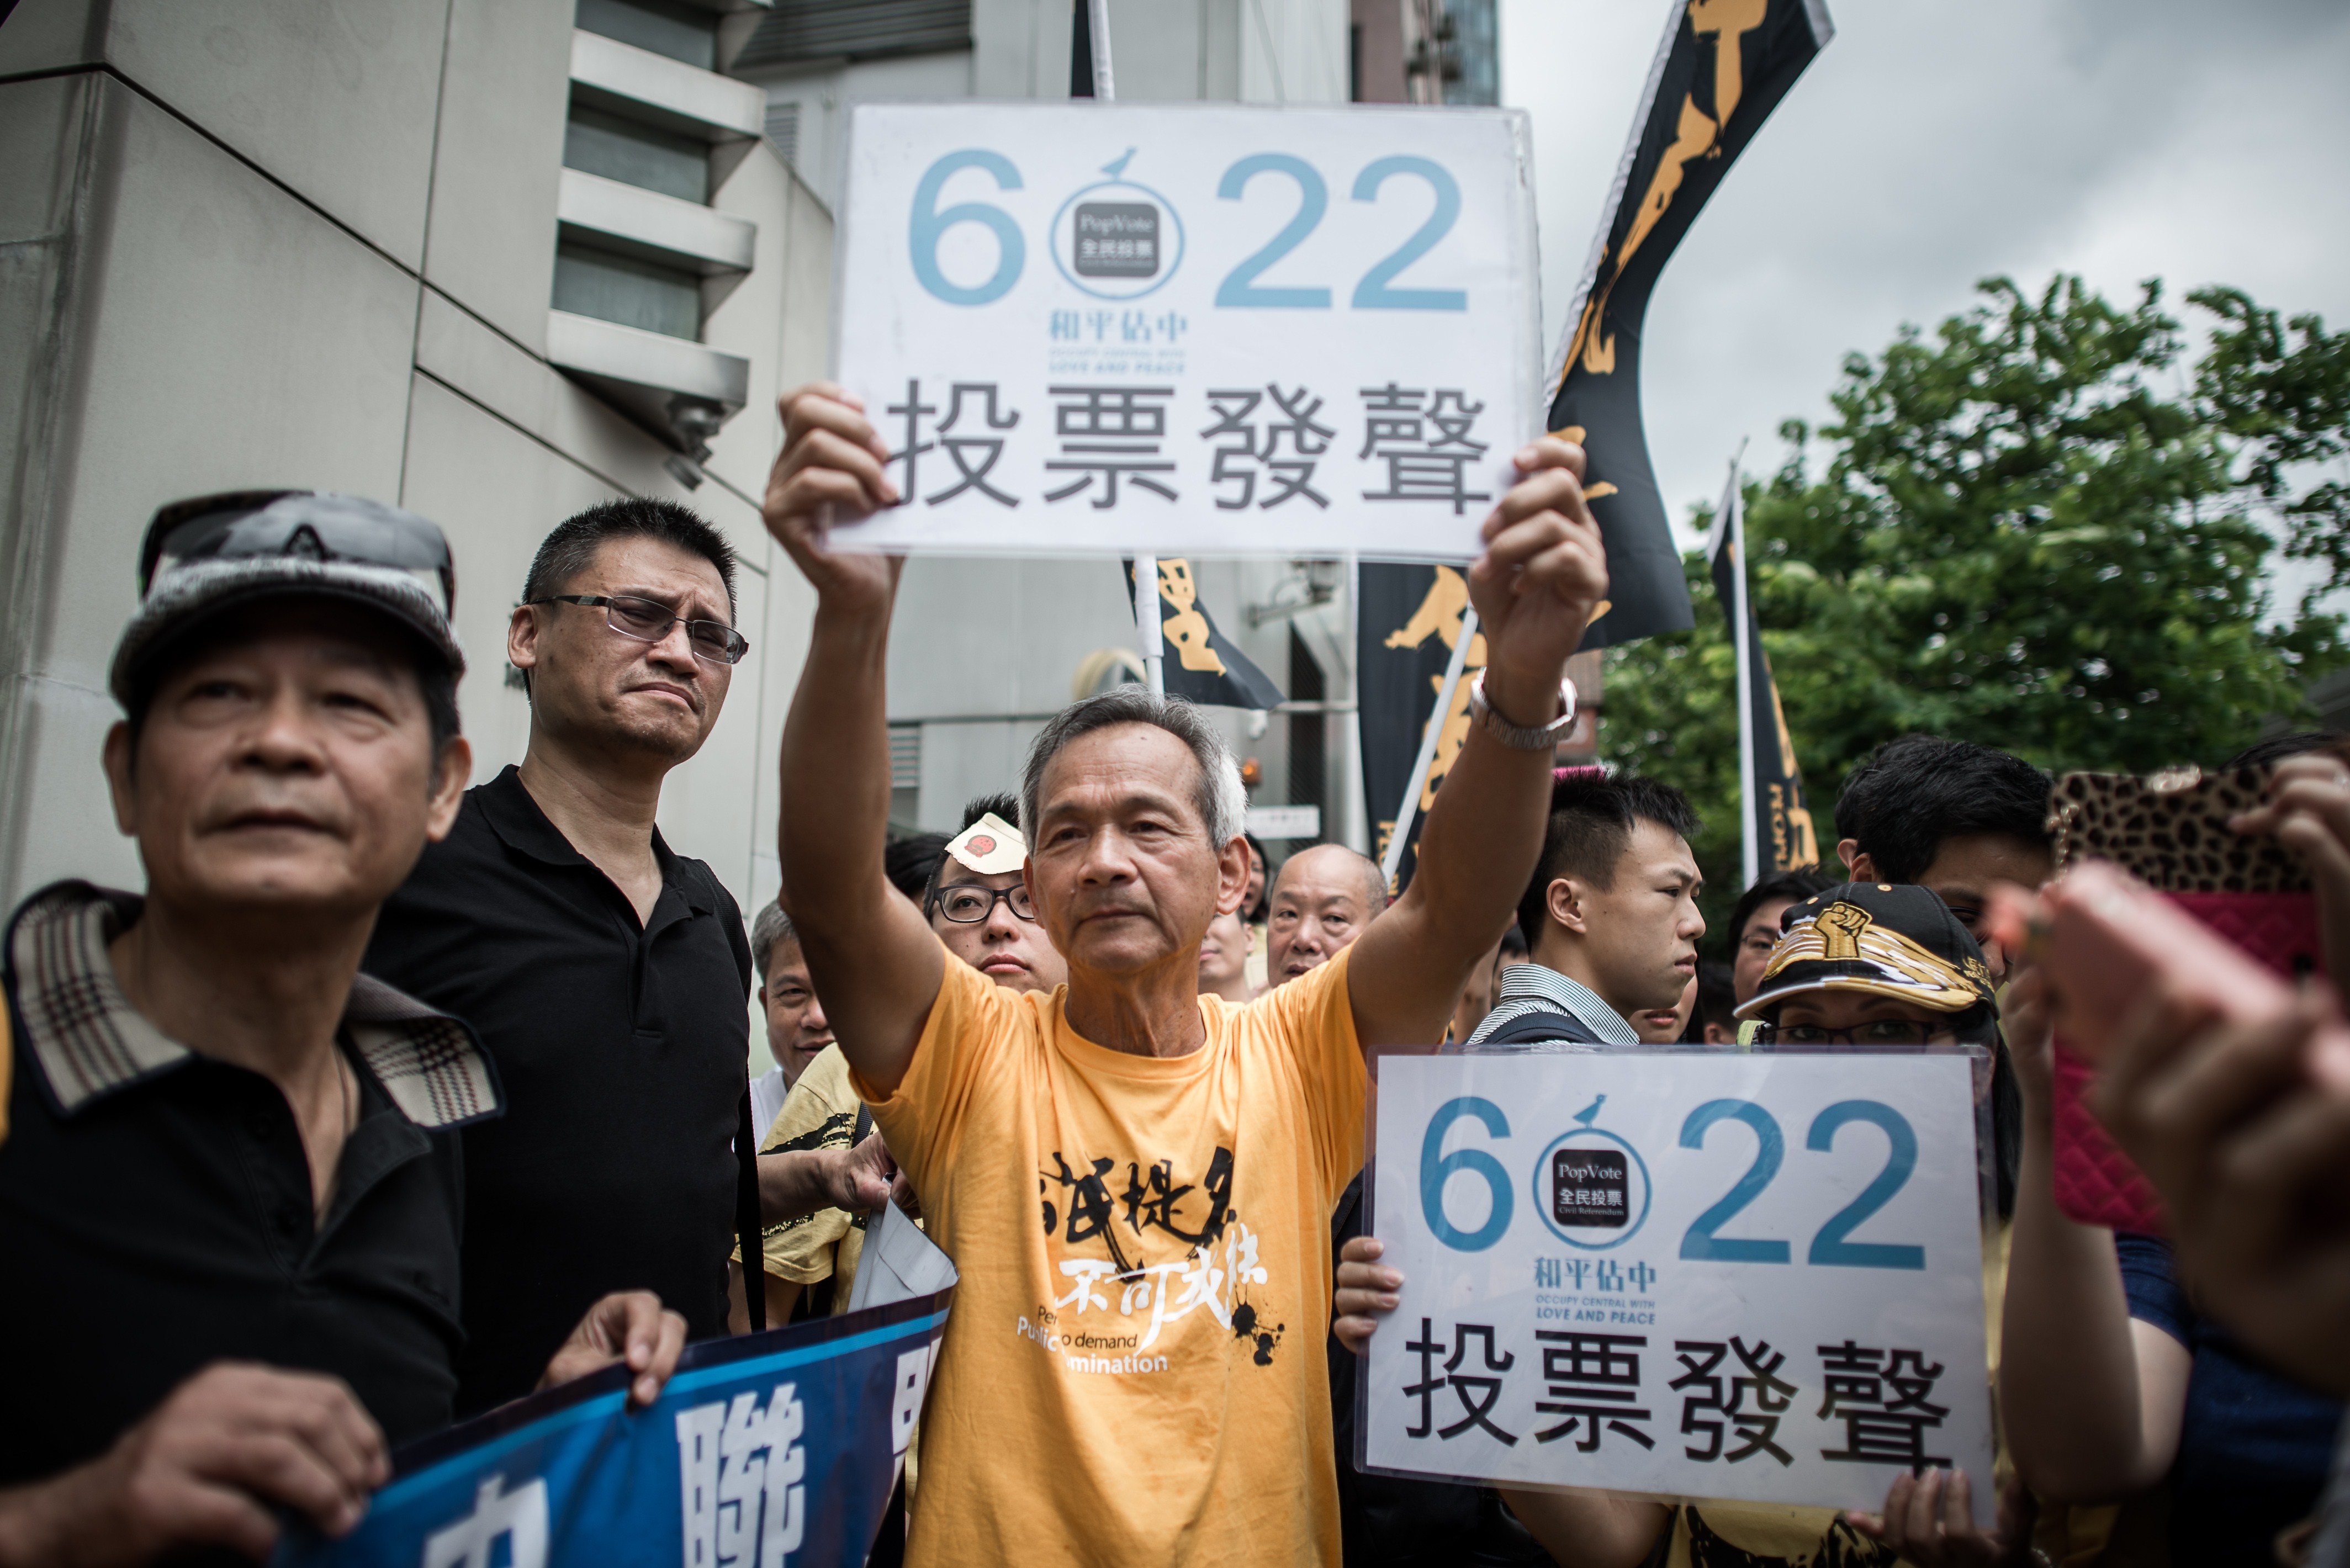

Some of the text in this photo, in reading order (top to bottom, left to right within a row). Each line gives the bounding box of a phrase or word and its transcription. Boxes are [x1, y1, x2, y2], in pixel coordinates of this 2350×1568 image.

[908, 148, 1026, 307] 6
[1214, 152, 1468, 312] 22
[1079, 213, 1155, 236] PopVote
[886, 378, 1492, 516] 投票發聲
[1419, 1095, 1927, 1272] 6 22
[1558, 1164, 1622, 1183] PopVote
[1560, 1189, 1623, 1206] 全民投票
[1558, 1206, 1624, 1216] Civil Referendum
[1534, 1257, 1656, 1293] 和平佔中
[1536, 1295, 1655, 1309] OCCUPY CENTRAL WITH
[1537, 1307, 1655, 1325] LOVE AND PEACE
[1075, 1332, 1137, 1349] demand
[1401, 1317, 1953, 1479] 投票發聲
